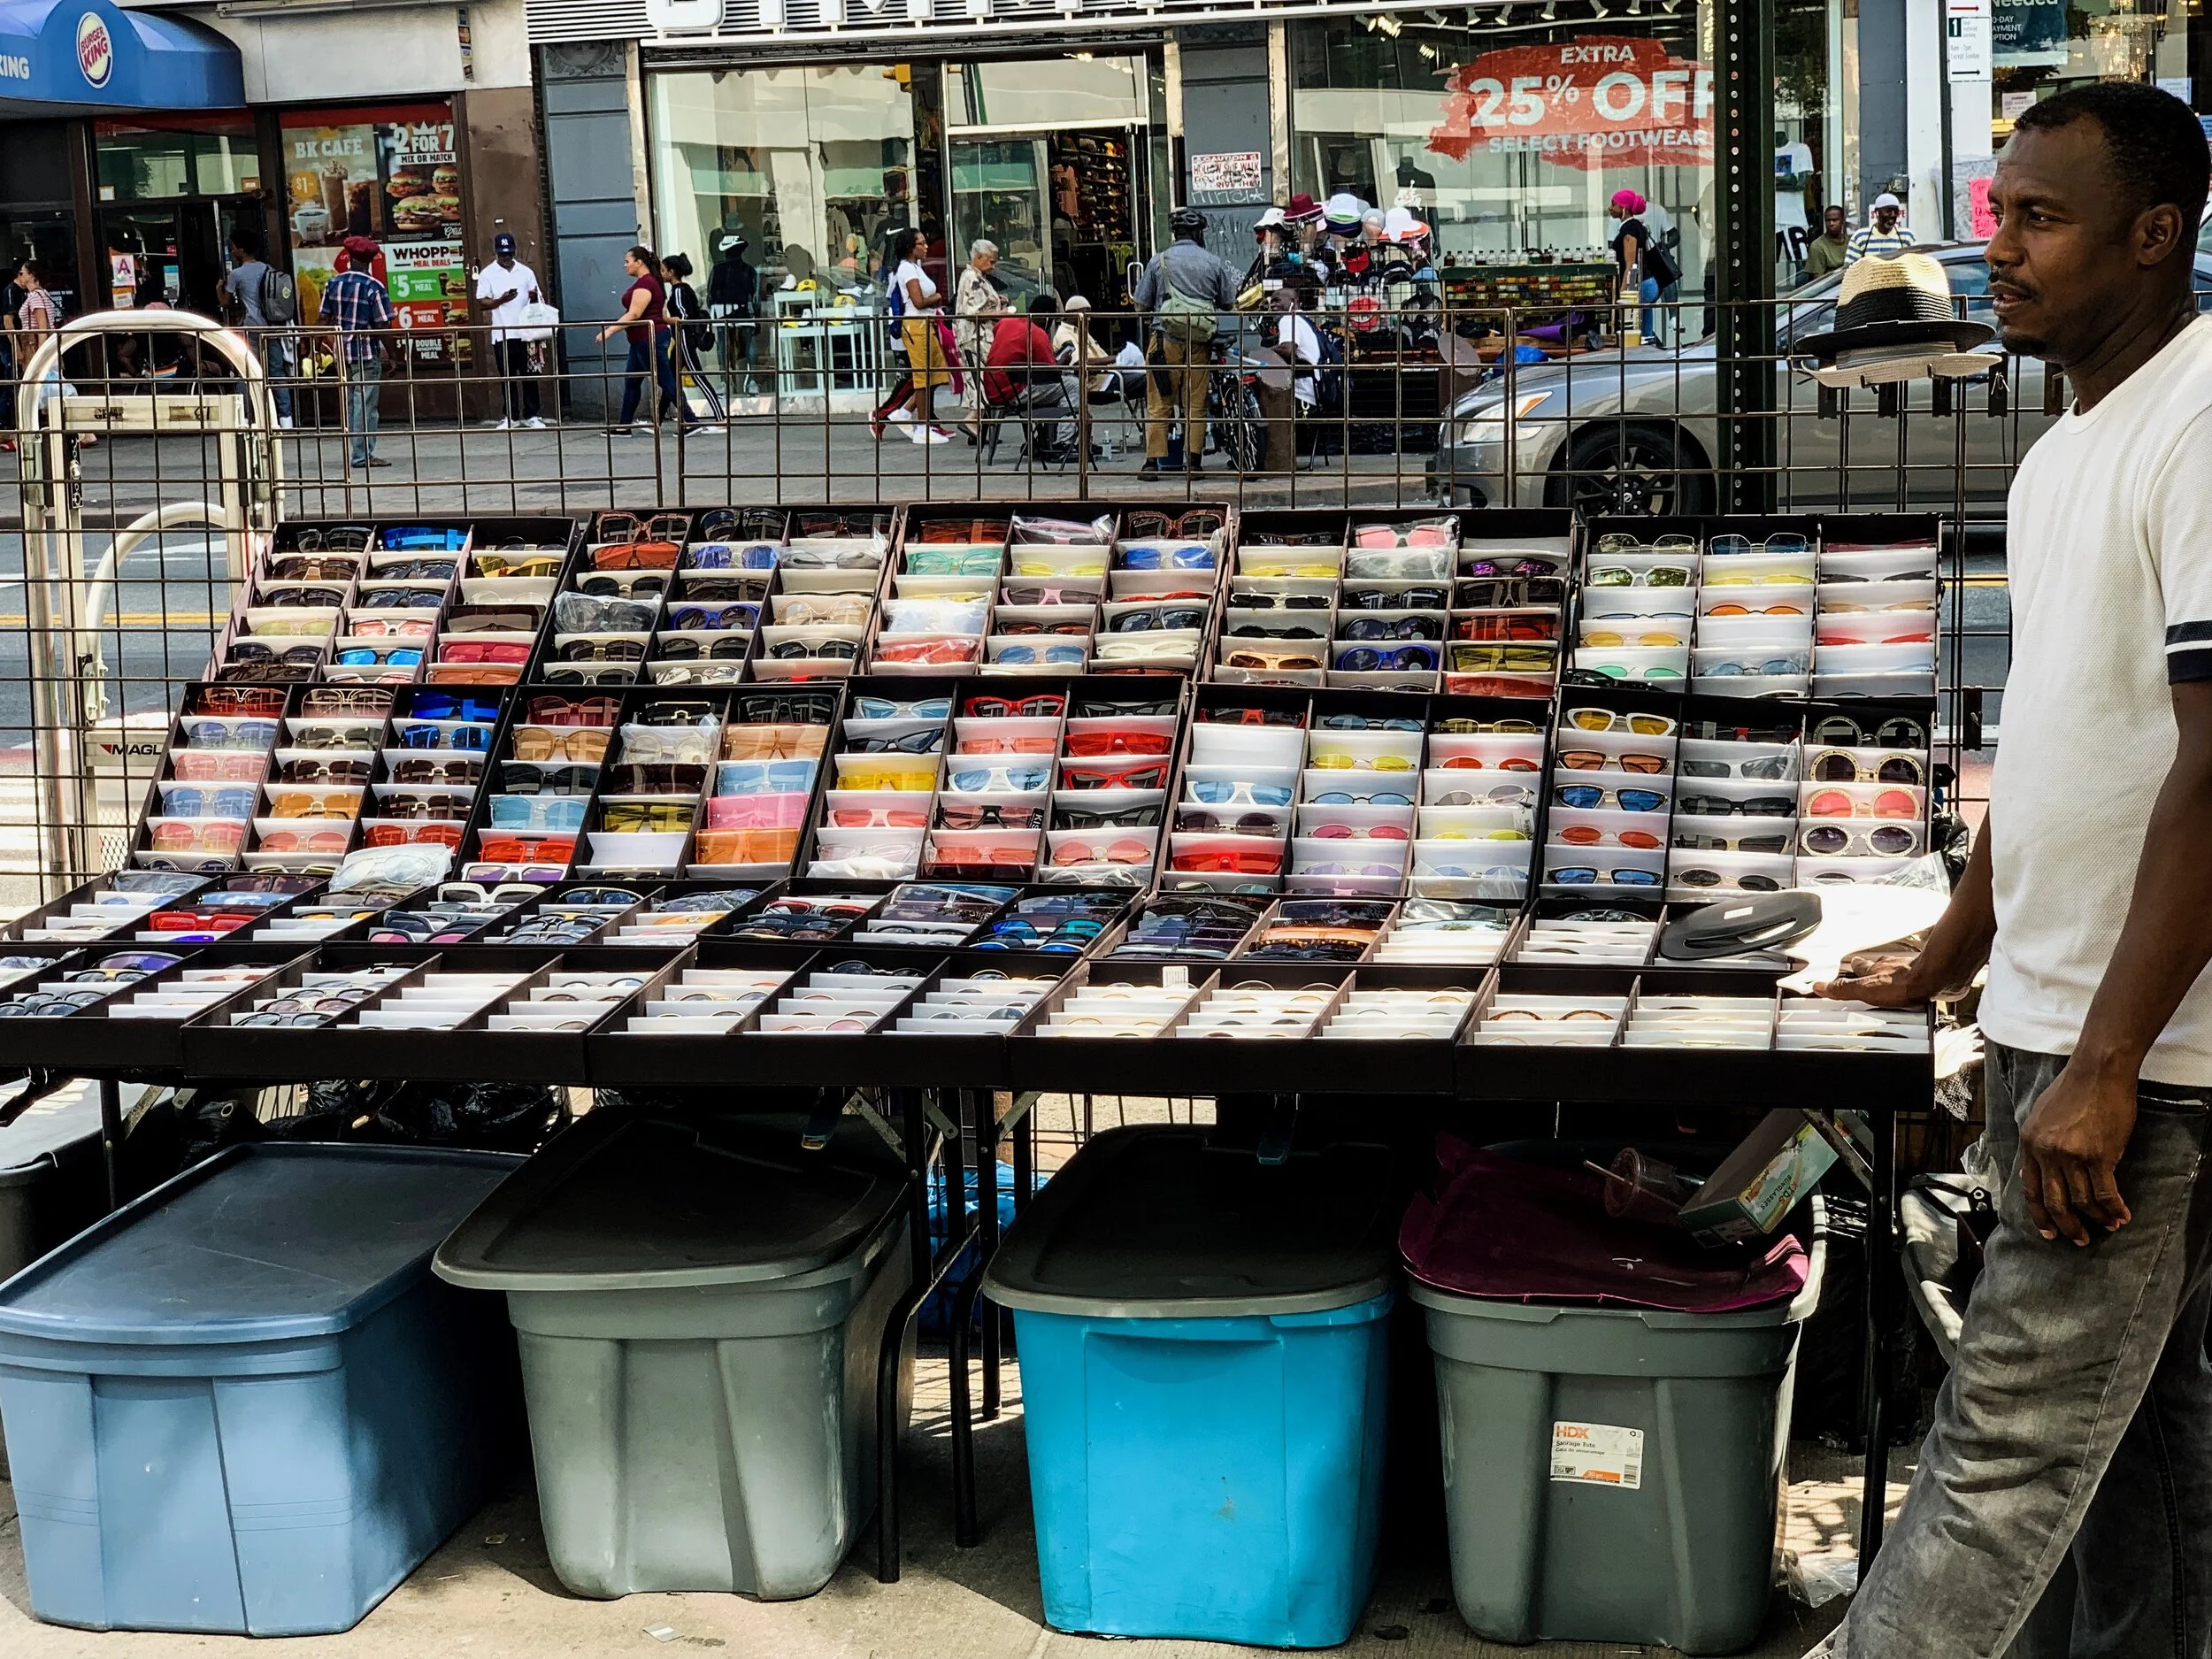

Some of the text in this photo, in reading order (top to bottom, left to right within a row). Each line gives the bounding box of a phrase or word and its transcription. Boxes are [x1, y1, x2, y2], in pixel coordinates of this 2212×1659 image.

[81, 26, 104, 53] BURGER
[1992, 33, 2016, 42] PTION
[84, 37, 109, 72] KING
[1561, 44, 1636, 65] EXTRA
[1467, 73, 1581, 127] 25%
[295, 141, 320, 158] BK
[411, 135, 439, 152] FOR
[1489, 128, 1709, 154] SELECT FOOTWEAR
[401, 152, 452, 164] MIX OR MATCH
[119, 258, 131, 275] A
[415, 283, 433, 292] MEAL
[415, 338, 442, 348] DOUBLE
[1761, 1174, 1792, 1210] SUNGLASSES
[1778, 1181, 1798, 1204] KIDS
[1556, 1425, 1589, 1440] HDX
